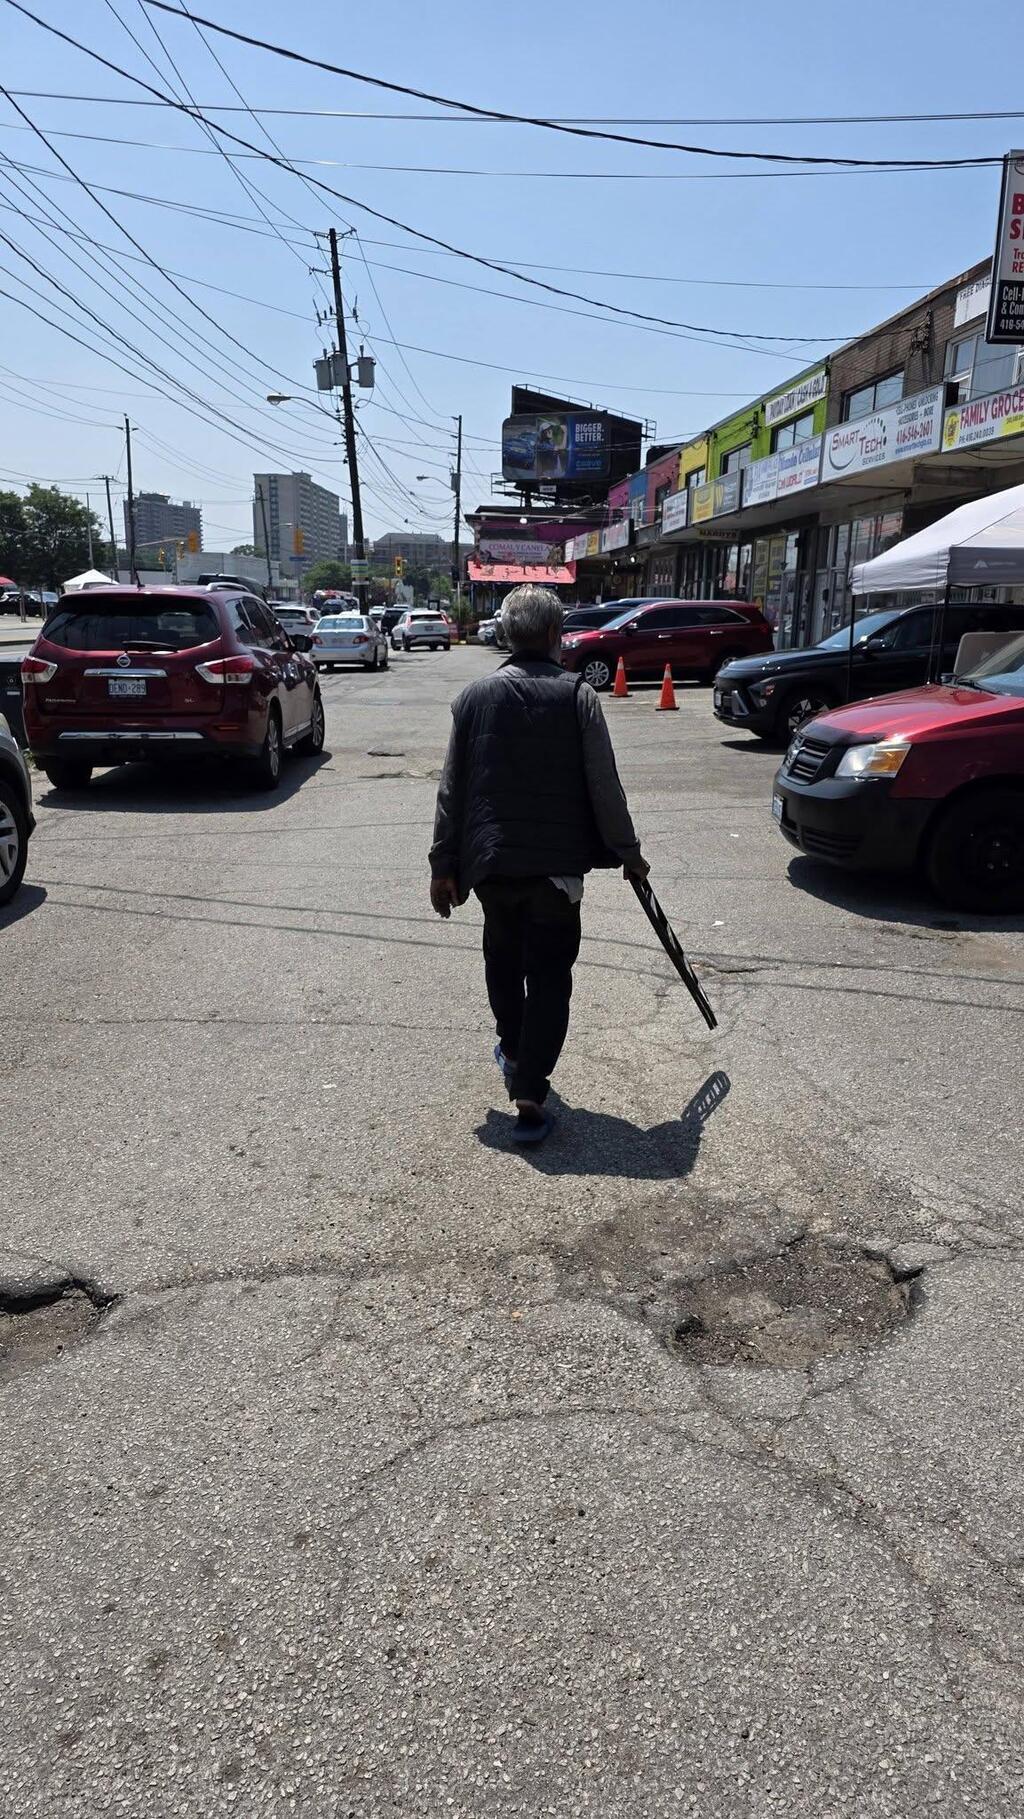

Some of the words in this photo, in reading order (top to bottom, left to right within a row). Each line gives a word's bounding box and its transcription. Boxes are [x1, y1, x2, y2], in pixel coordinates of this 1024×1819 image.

[1001, 302, 1007, 315] &
[960, 400, 989, 429] FAMILY
[575, 423, 604, 433] BIGGER.
[575, 432, 604, 442] BETTER.
[832, 429, 860, 451] SMART
[859, 436, 883, 456] TECH
[862, 452, 885, 466] SERVICES
